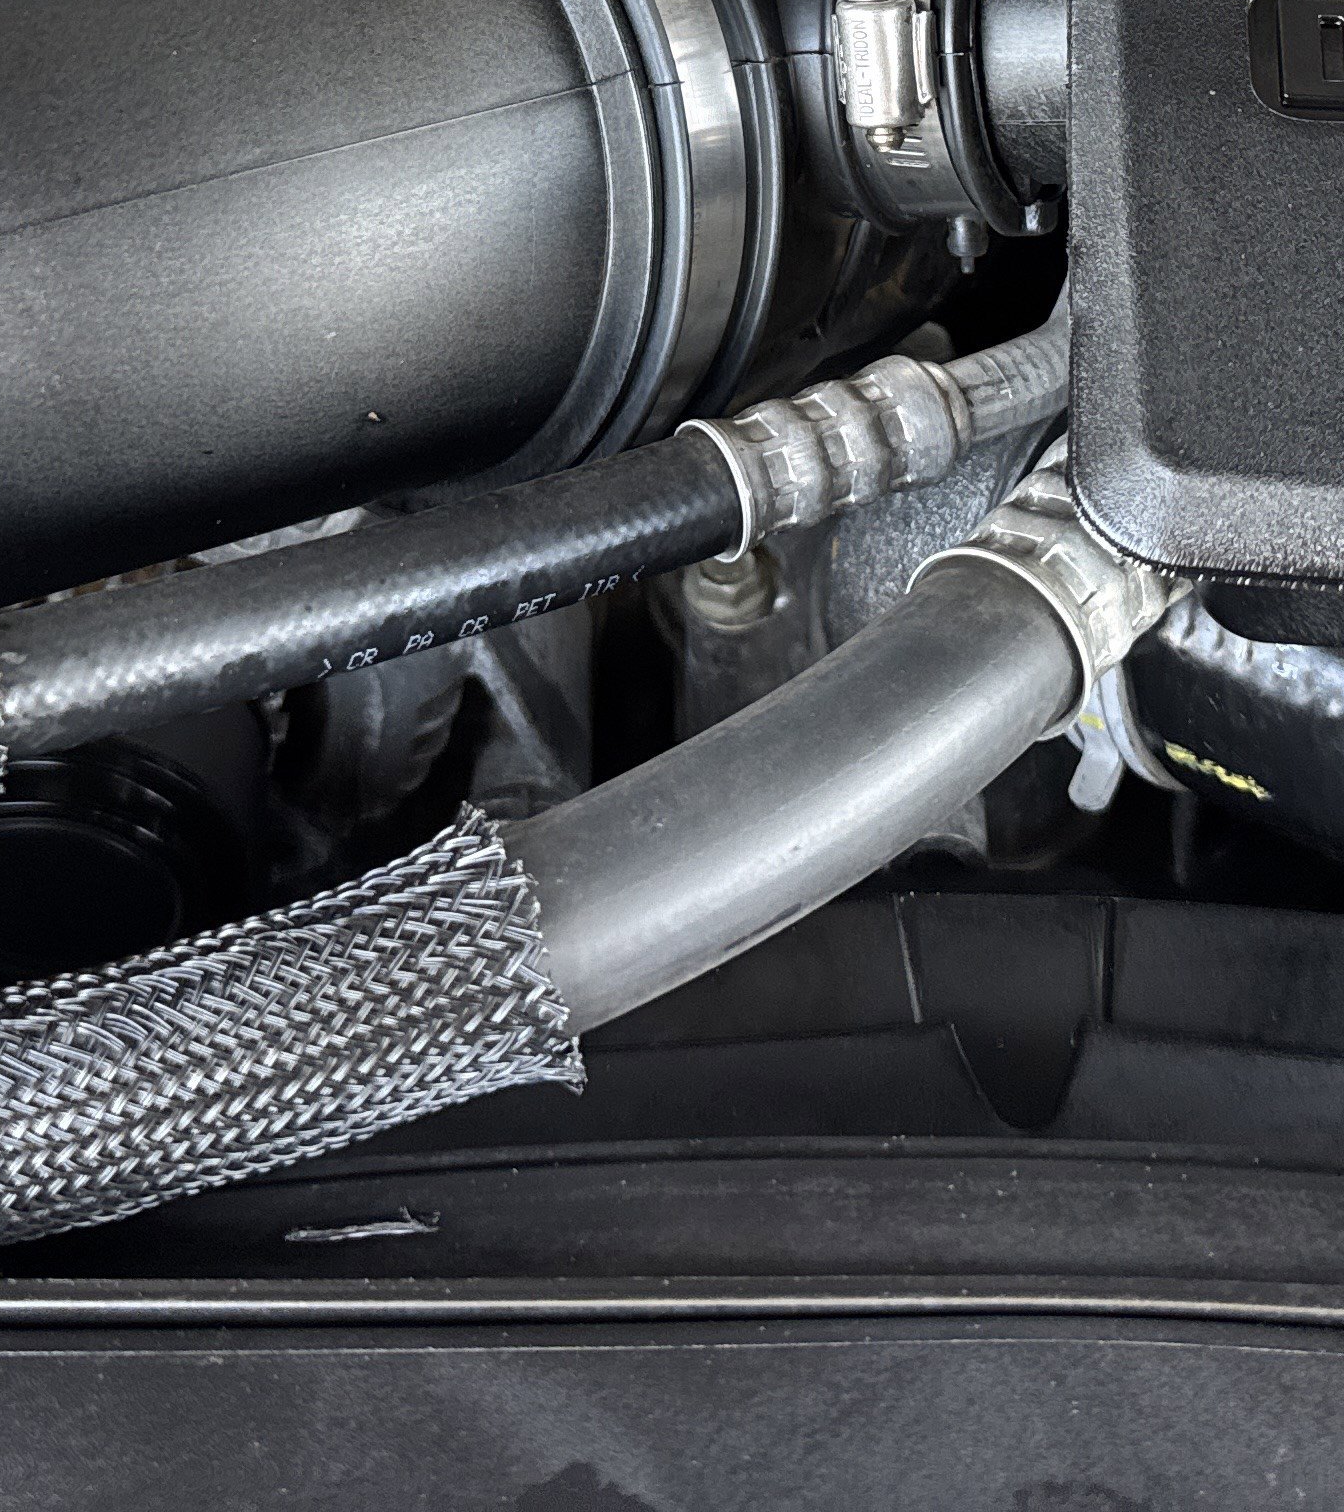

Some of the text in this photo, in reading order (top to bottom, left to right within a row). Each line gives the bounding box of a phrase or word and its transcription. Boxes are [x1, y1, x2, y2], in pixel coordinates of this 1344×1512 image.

[853, 19, 875, 122] IDEAL-TRIDON
[346, 647, 379, 672] CR
[402, 630, 435, 656] PA
[458, 614, 489, 639] CR
[512, 592, 557, 622] PET
